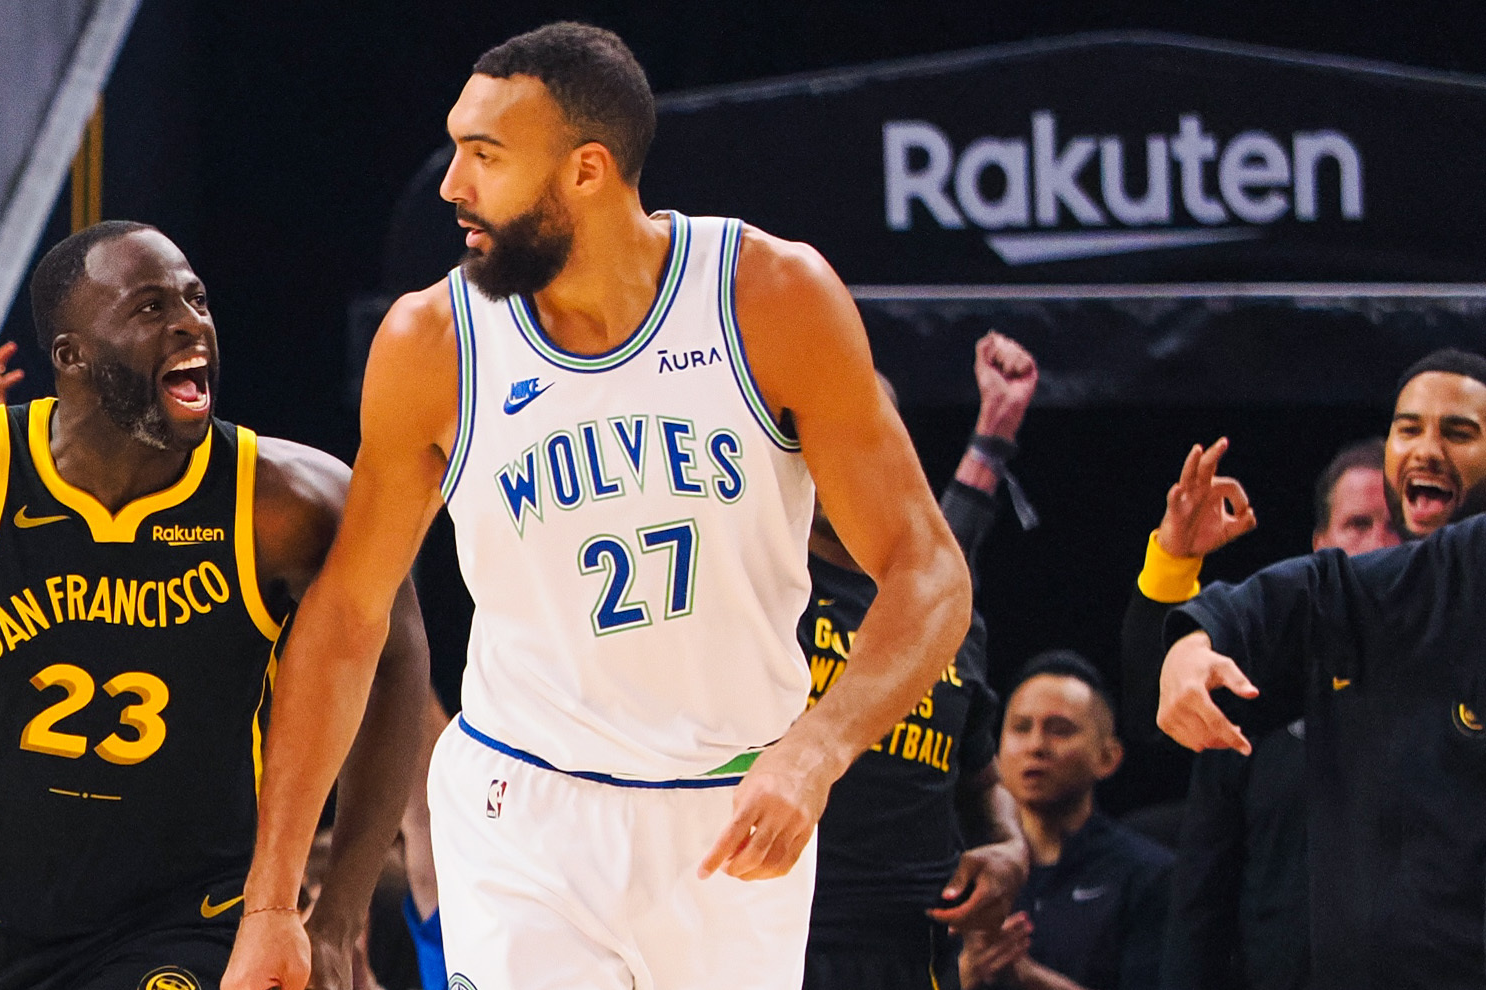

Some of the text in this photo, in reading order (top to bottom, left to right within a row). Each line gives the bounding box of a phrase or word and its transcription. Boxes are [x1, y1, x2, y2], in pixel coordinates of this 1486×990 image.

[882, 109, 1364, 230] Rakuten
[494, 414, 746, 540] WOLVES
[152, 525, 225, 542] Rakuten
[577, 517, 700, 638] 27
[45, 560, 230, 628] FRANCISCO
[19, 663, 170, 766] 23
